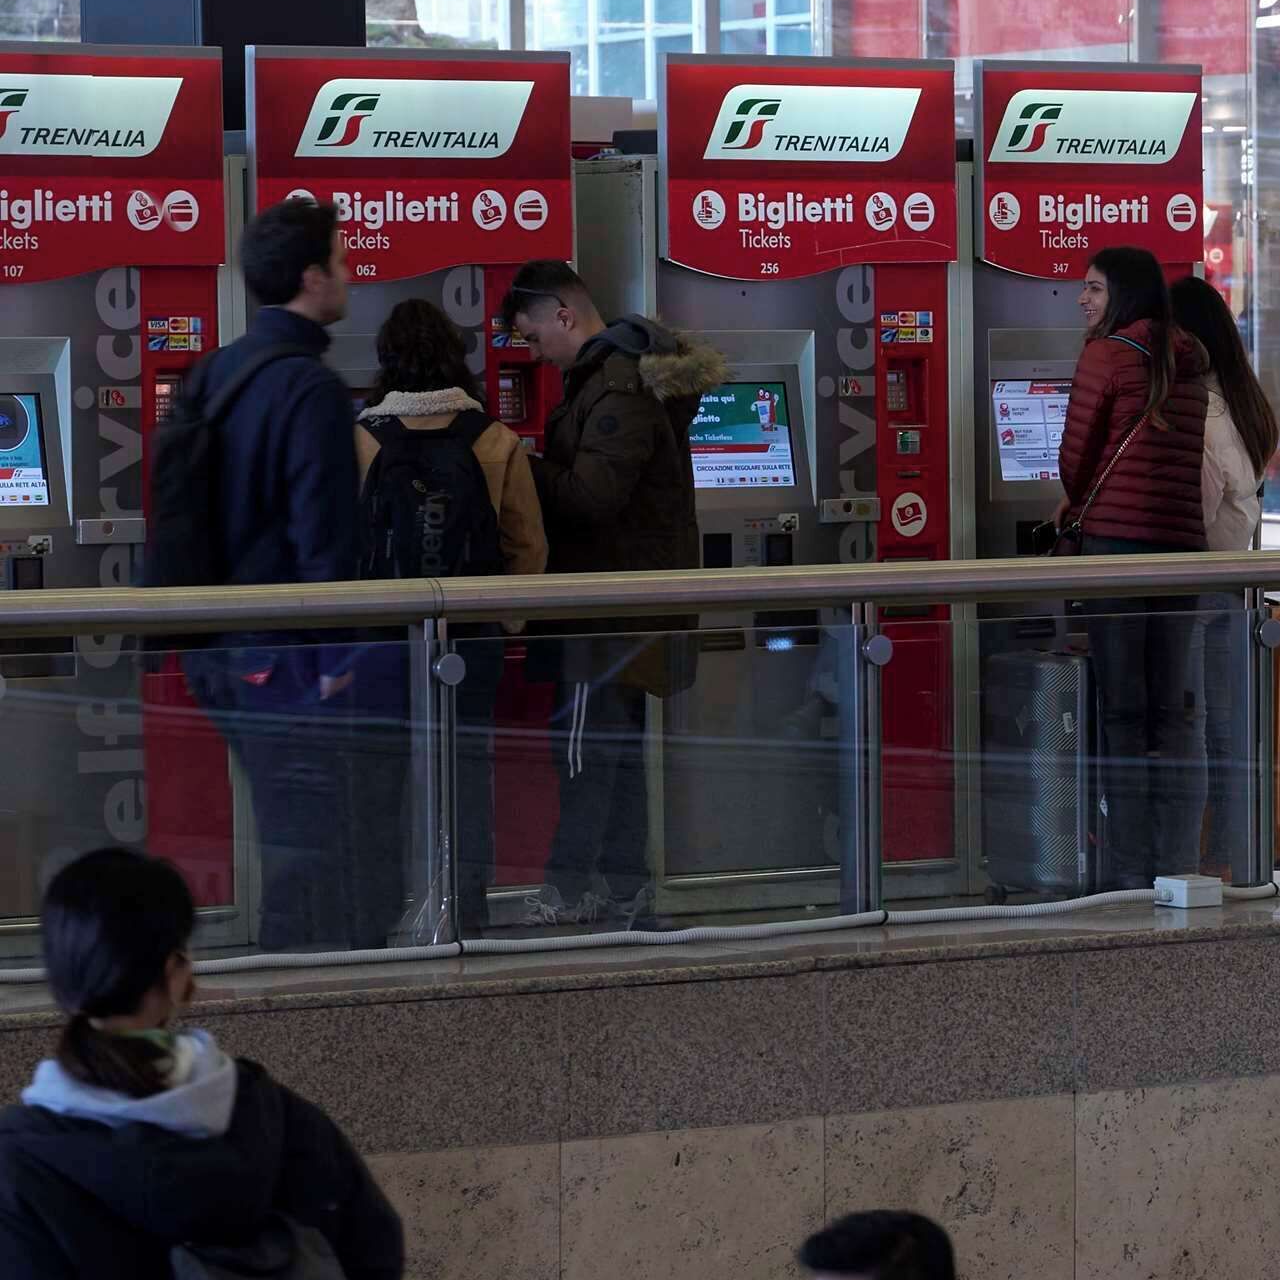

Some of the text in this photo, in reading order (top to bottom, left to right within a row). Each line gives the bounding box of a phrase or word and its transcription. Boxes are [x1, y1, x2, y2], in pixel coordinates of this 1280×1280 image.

[372, 130, 499, 149] TRENITALIA
[774, 135, 890, 153] TRENITALIA
[1056, 138, 1166, 156] TRENITALIA
[0, 189, 113, 230] iglietti
[332, 190, 459, 230] Biglietti
[738, 192, 854, 230] Biglietti
[1038, 194, 1149, 230] Biglietti
[0, 228, 39, 250] kets
[739, 228, 791, 250] Tickets
[1039, 229, 1089, 249] Tickets
[3, 265, 24, 277] 107
[356, 264, 377, 276] 062
[760, 263, 780, 274] 256
[1053, 263, 1069, 273] 347
[721, 393, 736, 404] qui
[692, 414, 721, 425] glietto
[696, 464, 734, 472] CIRCOLAZIONE
